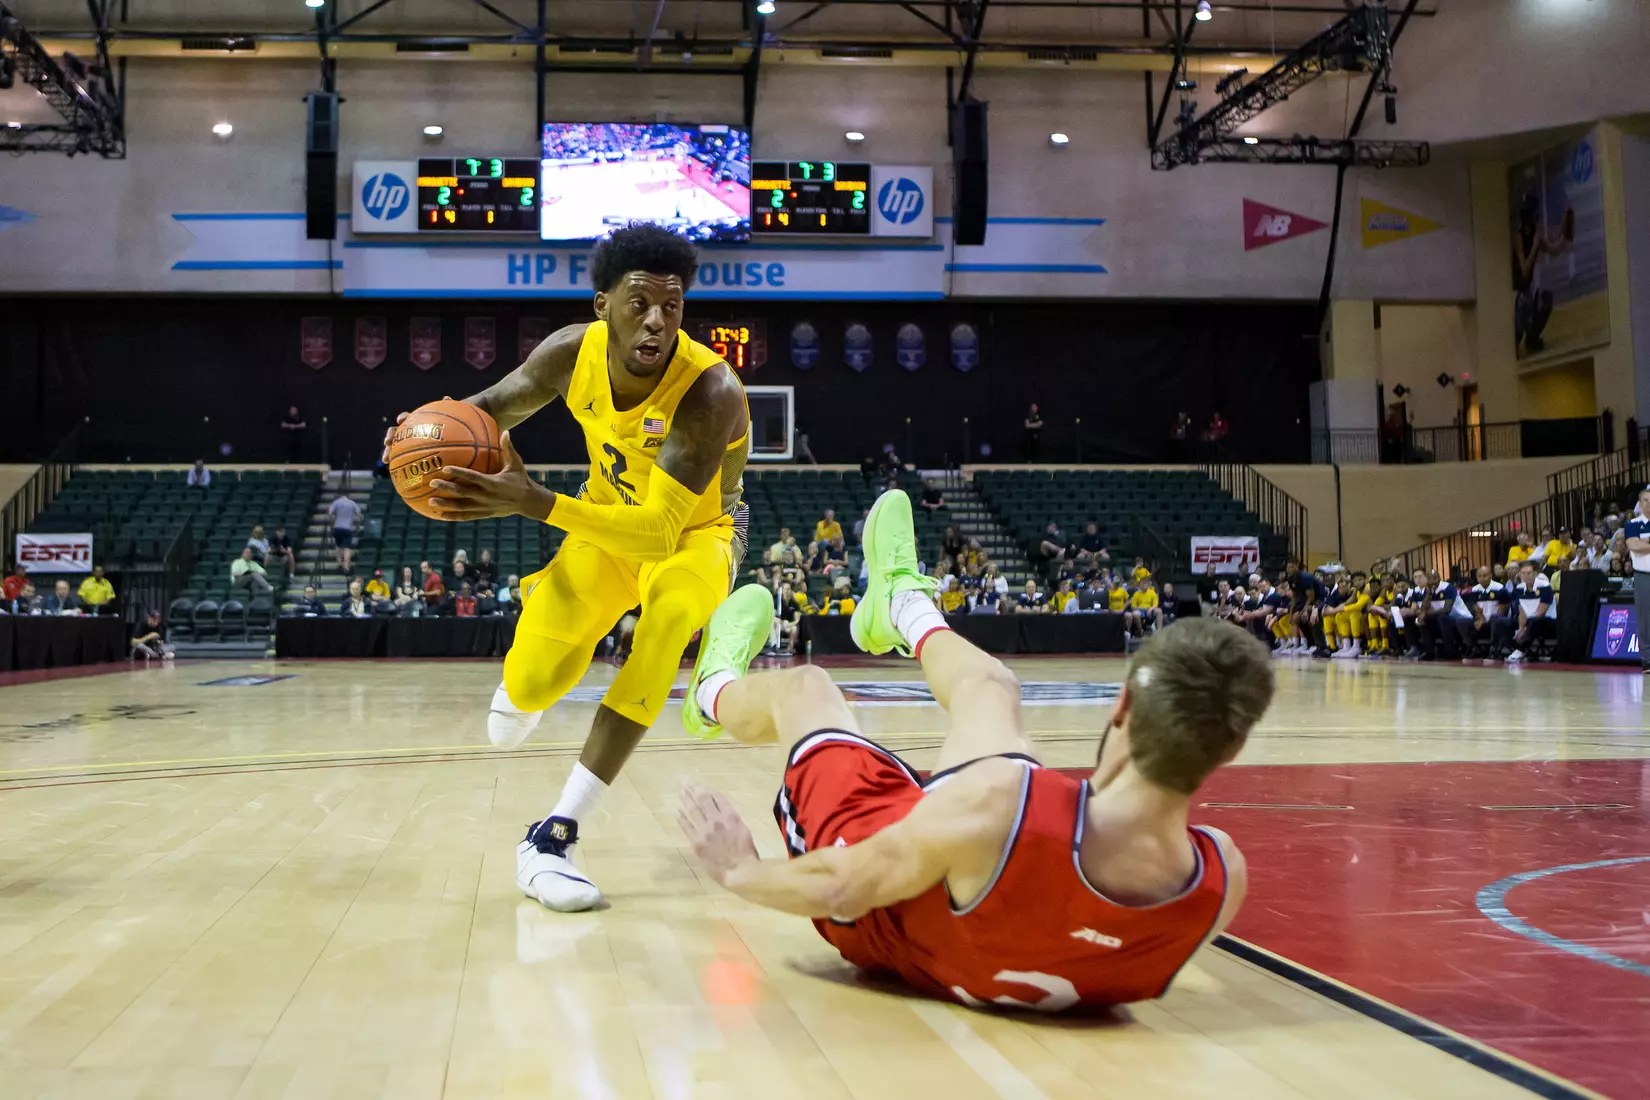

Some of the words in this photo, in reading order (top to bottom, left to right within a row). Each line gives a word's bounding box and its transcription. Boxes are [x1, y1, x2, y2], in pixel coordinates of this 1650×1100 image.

[366, 173, 403, 221] hp
[437, 186, 451, 206] 2
[520, 186, 534, 206] 2
[771, 189, 784, 209] 2
[852, 190, 865, 209] 2
[884, 178, 917, 225] hp
[508, 253, 557, 285] HP
[700, 261, 786, 287] ouse
[710, 327, 749, 344] 17:43
[602, 442, 636, 492] 2
[21, 544, 89, 561] ESPN
[1194, 546, 1259, 563] ESPN
